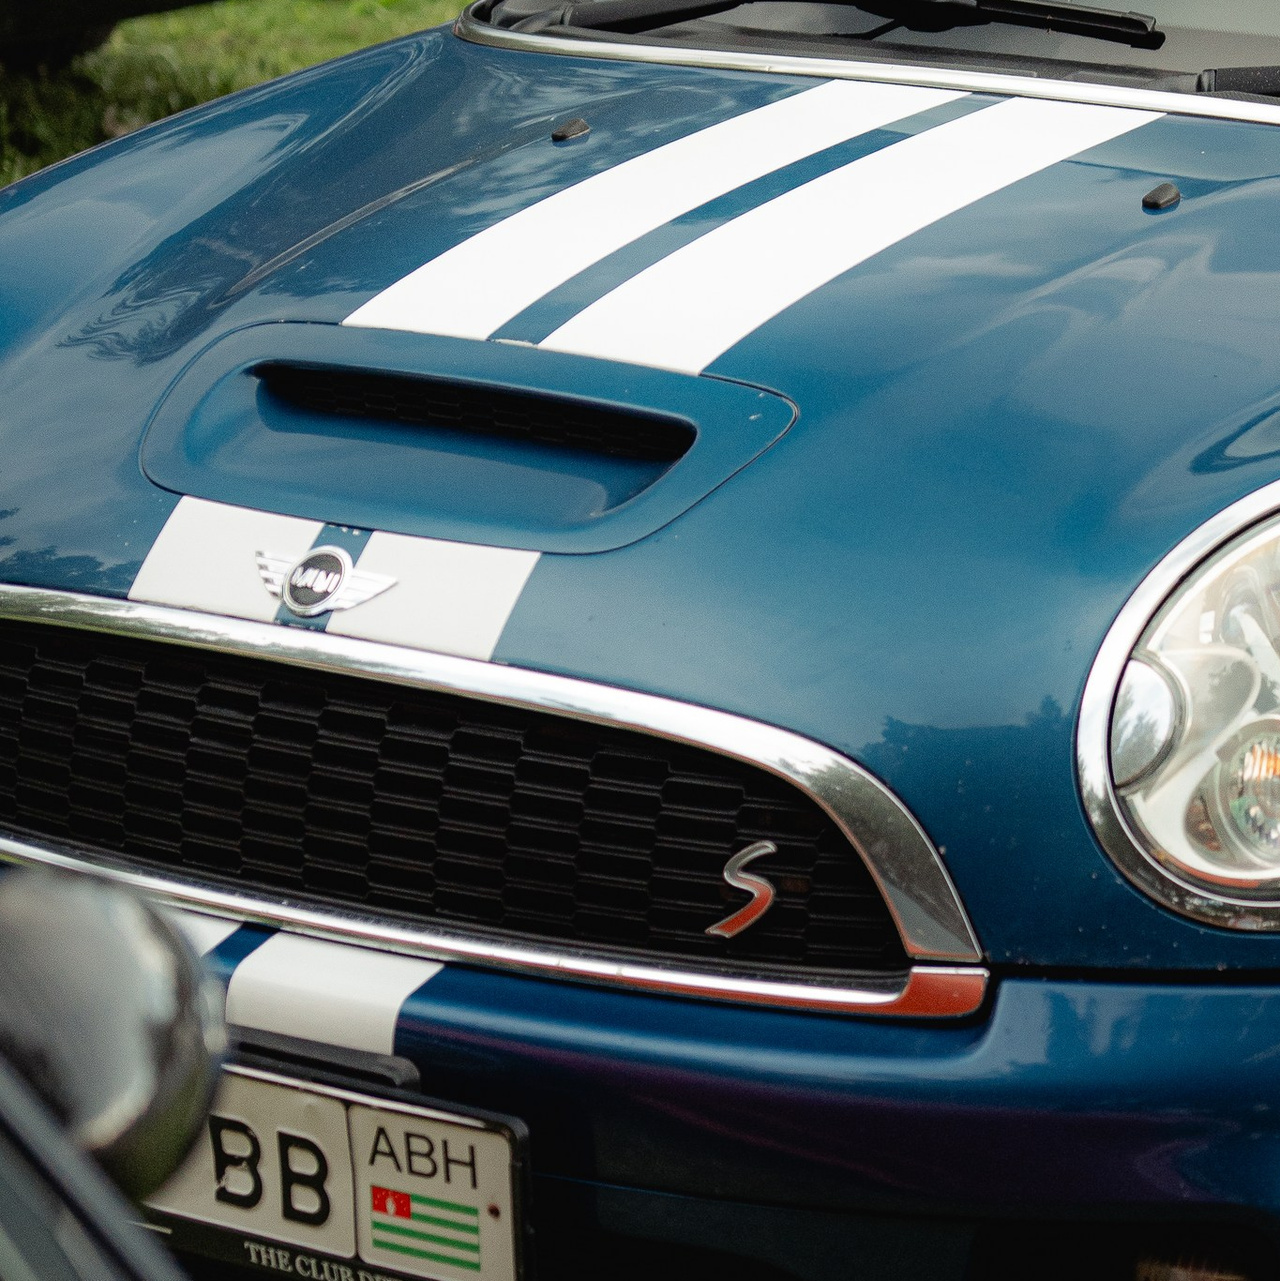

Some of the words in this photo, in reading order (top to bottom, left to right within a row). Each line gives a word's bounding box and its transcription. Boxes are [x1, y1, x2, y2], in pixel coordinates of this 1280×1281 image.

[291, 566, 342, 594] MINI
[704, 839, 778, 939] S
[368, 1126, 479, 1189] ABH
[244, 1241, 293, 1274] THE
